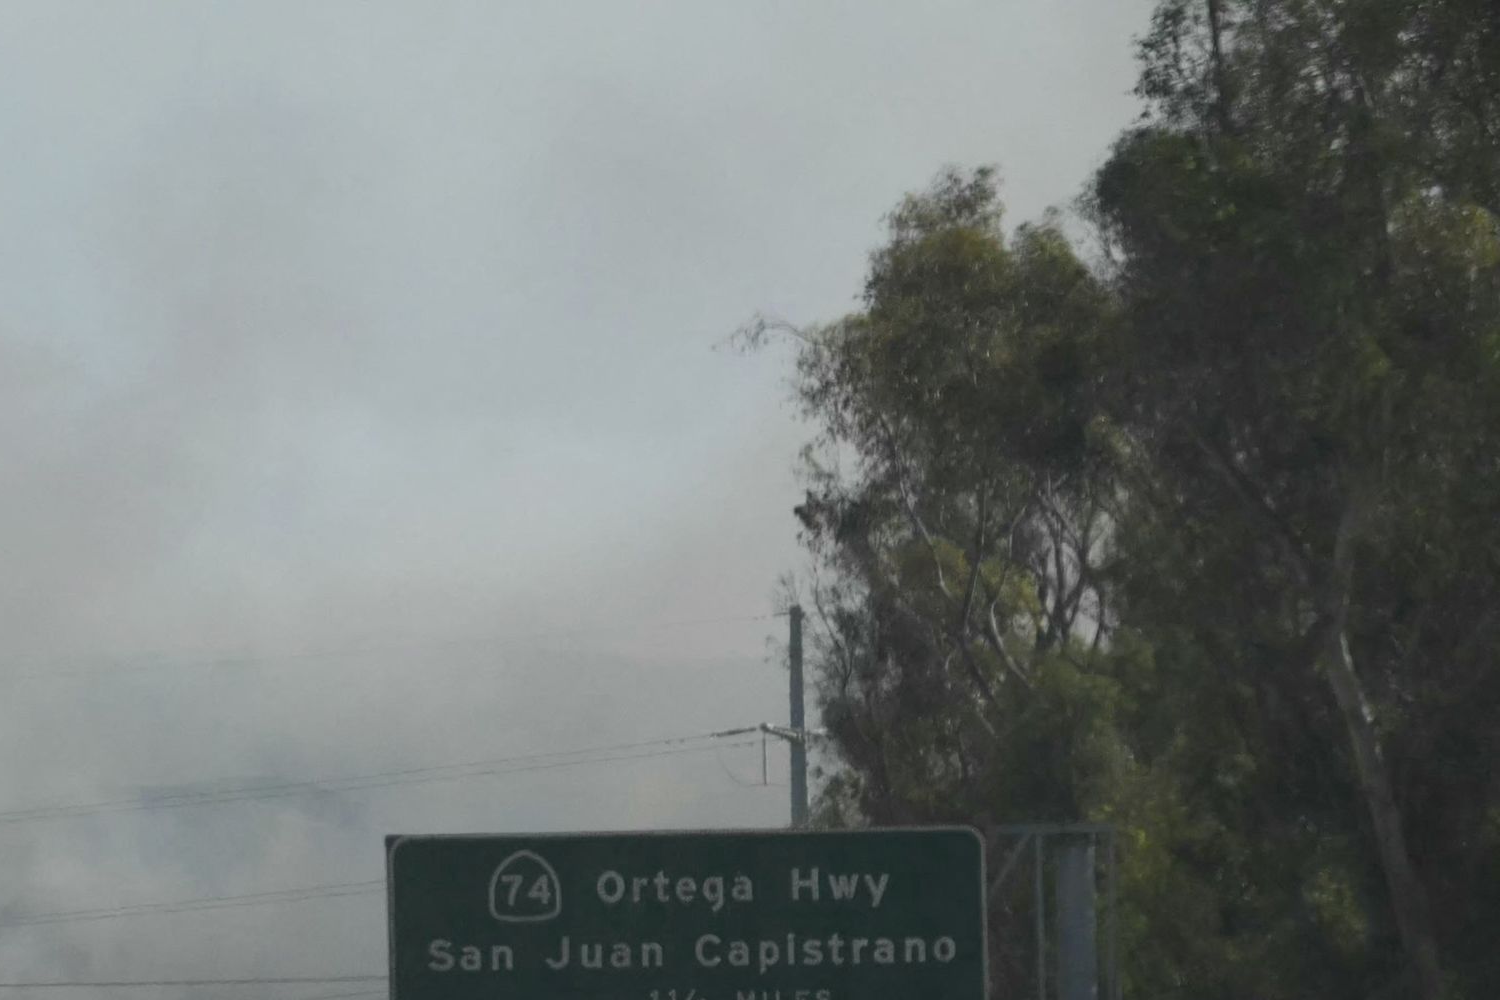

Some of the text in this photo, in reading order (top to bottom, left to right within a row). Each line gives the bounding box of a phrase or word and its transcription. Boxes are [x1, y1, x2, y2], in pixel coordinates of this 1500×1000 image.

[500, 867, 890, 912] 74 Ortega Hwy
[427, 932, 958, 975] San Juan Capistrano
